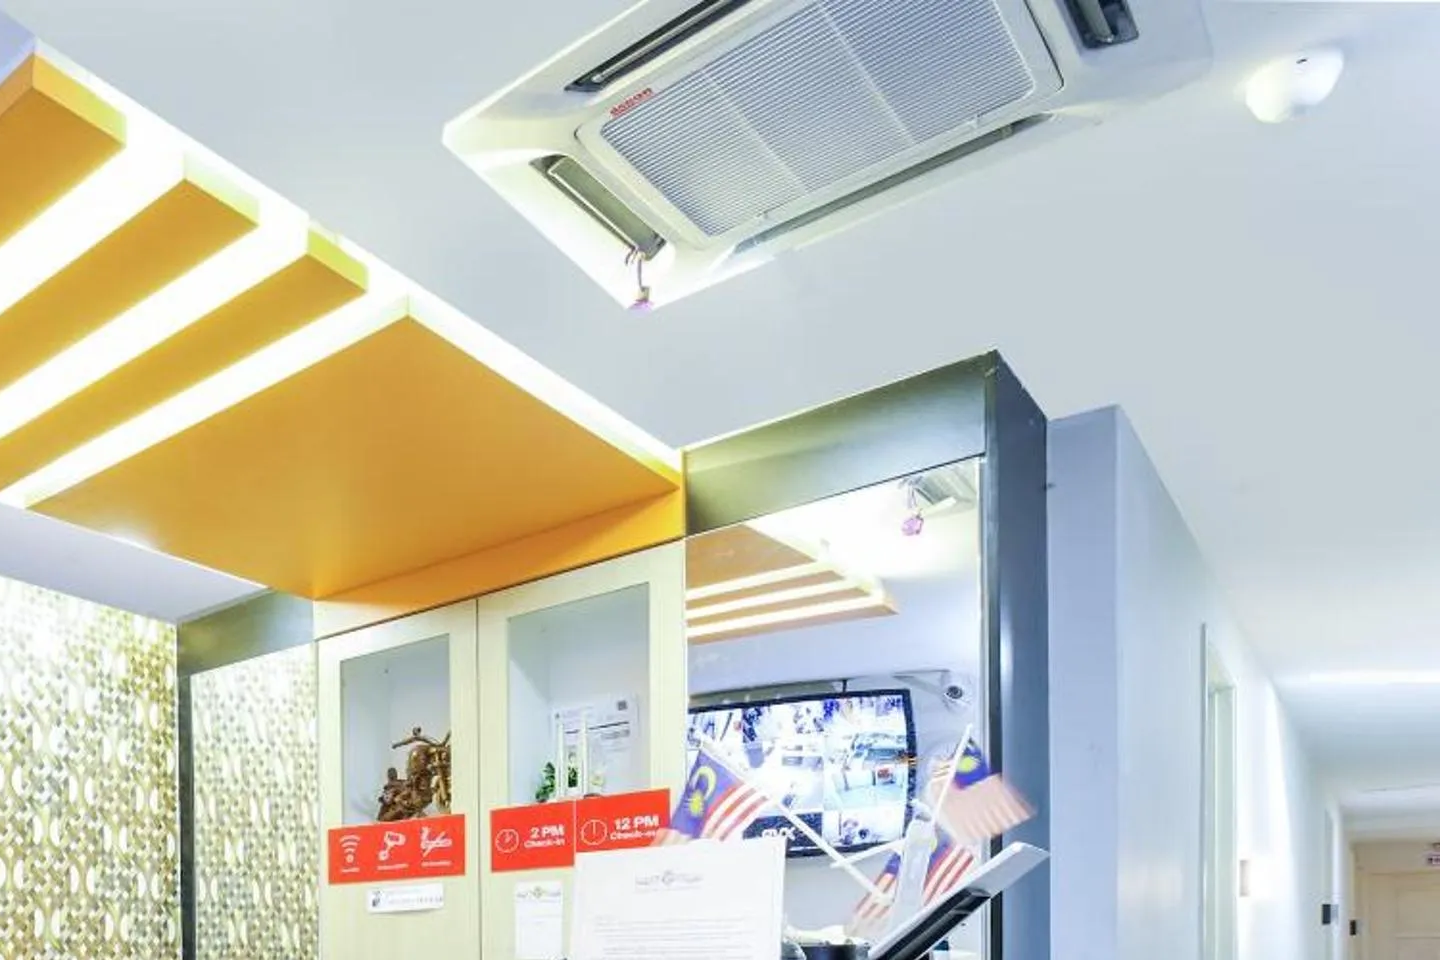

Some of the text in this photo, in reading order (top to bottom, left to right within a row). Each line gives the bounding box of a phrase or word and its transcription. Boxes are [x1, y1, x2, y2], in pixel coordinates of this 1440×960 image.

[615, 814, 660, 830] 12 PM
[530, 824, 565, 838] 2 PM
